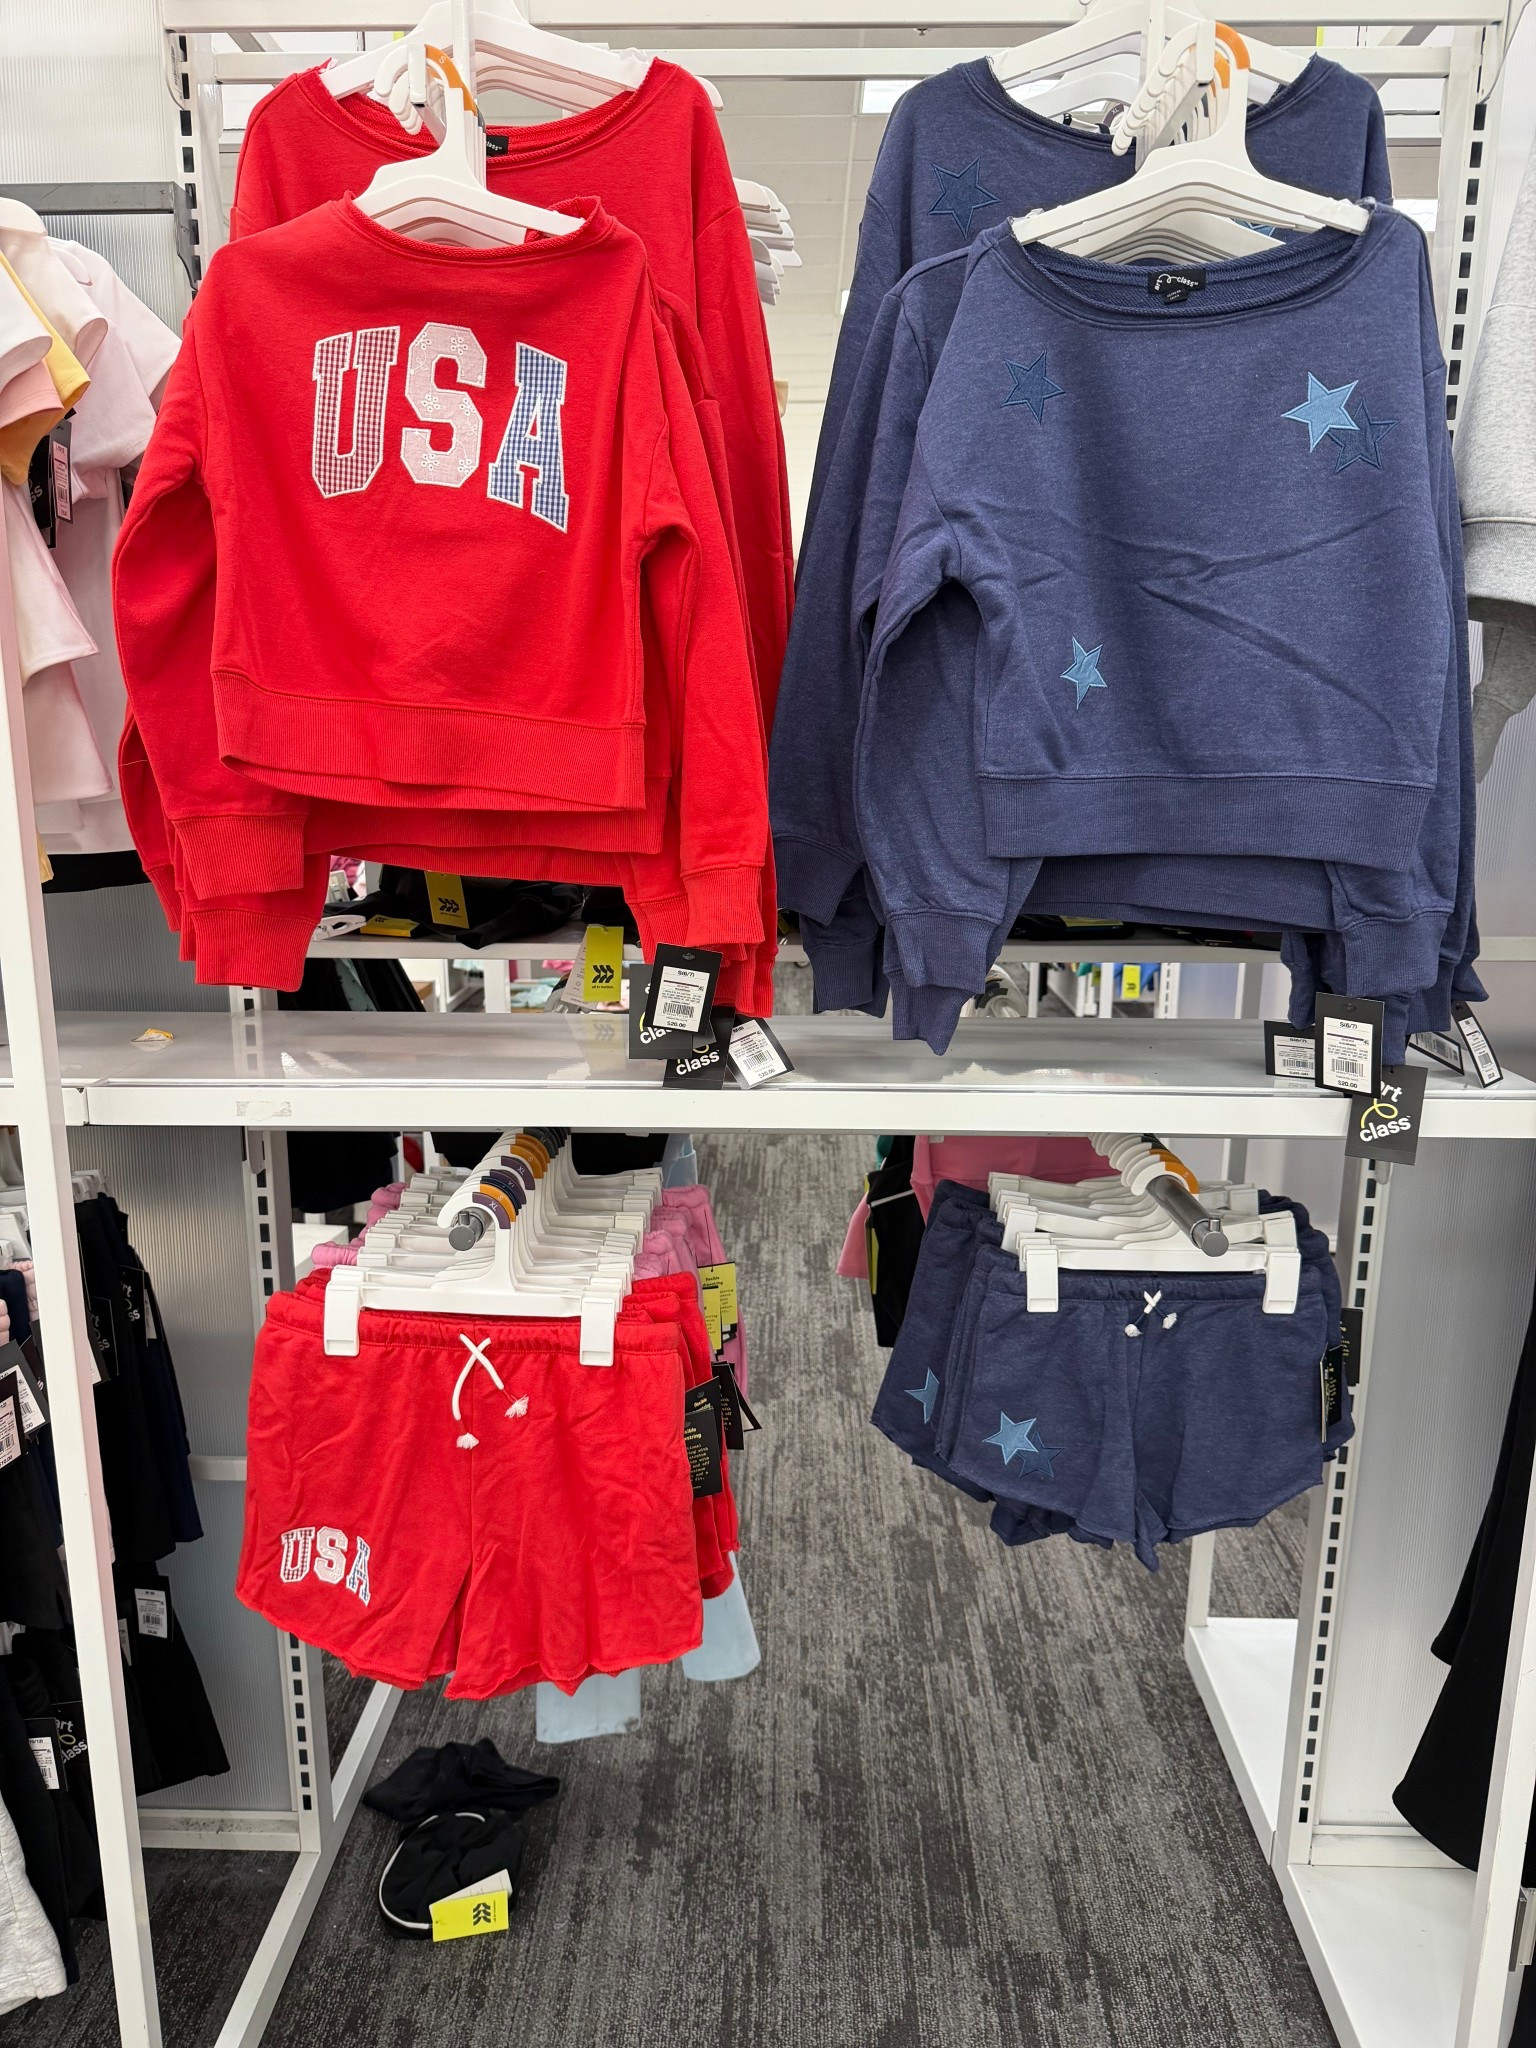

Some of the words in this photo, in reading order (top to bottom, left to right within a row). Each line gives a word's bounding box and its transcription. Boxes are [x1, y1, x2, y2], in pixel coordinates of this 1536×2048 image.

[1111, 106, 1121, 114] XL
[1154, 277, 1163, 291] art
[1177, 276, 1194, 287] class
[312, 322, 569, 534] USA
[1340, 1022, 1358, 1030] S(6/7)
[640, 1026, 673, 1044] cla
[676, 1051, 720, 1075] class
[1338, 1079, 1358, 1089] $20.00
[1360, 1117, 1411, 1142] class
[517, 1166, 526, 1176] XL
[489, 1200, 499, 1212] XL
[280, 1526, 371, 1607] USA
